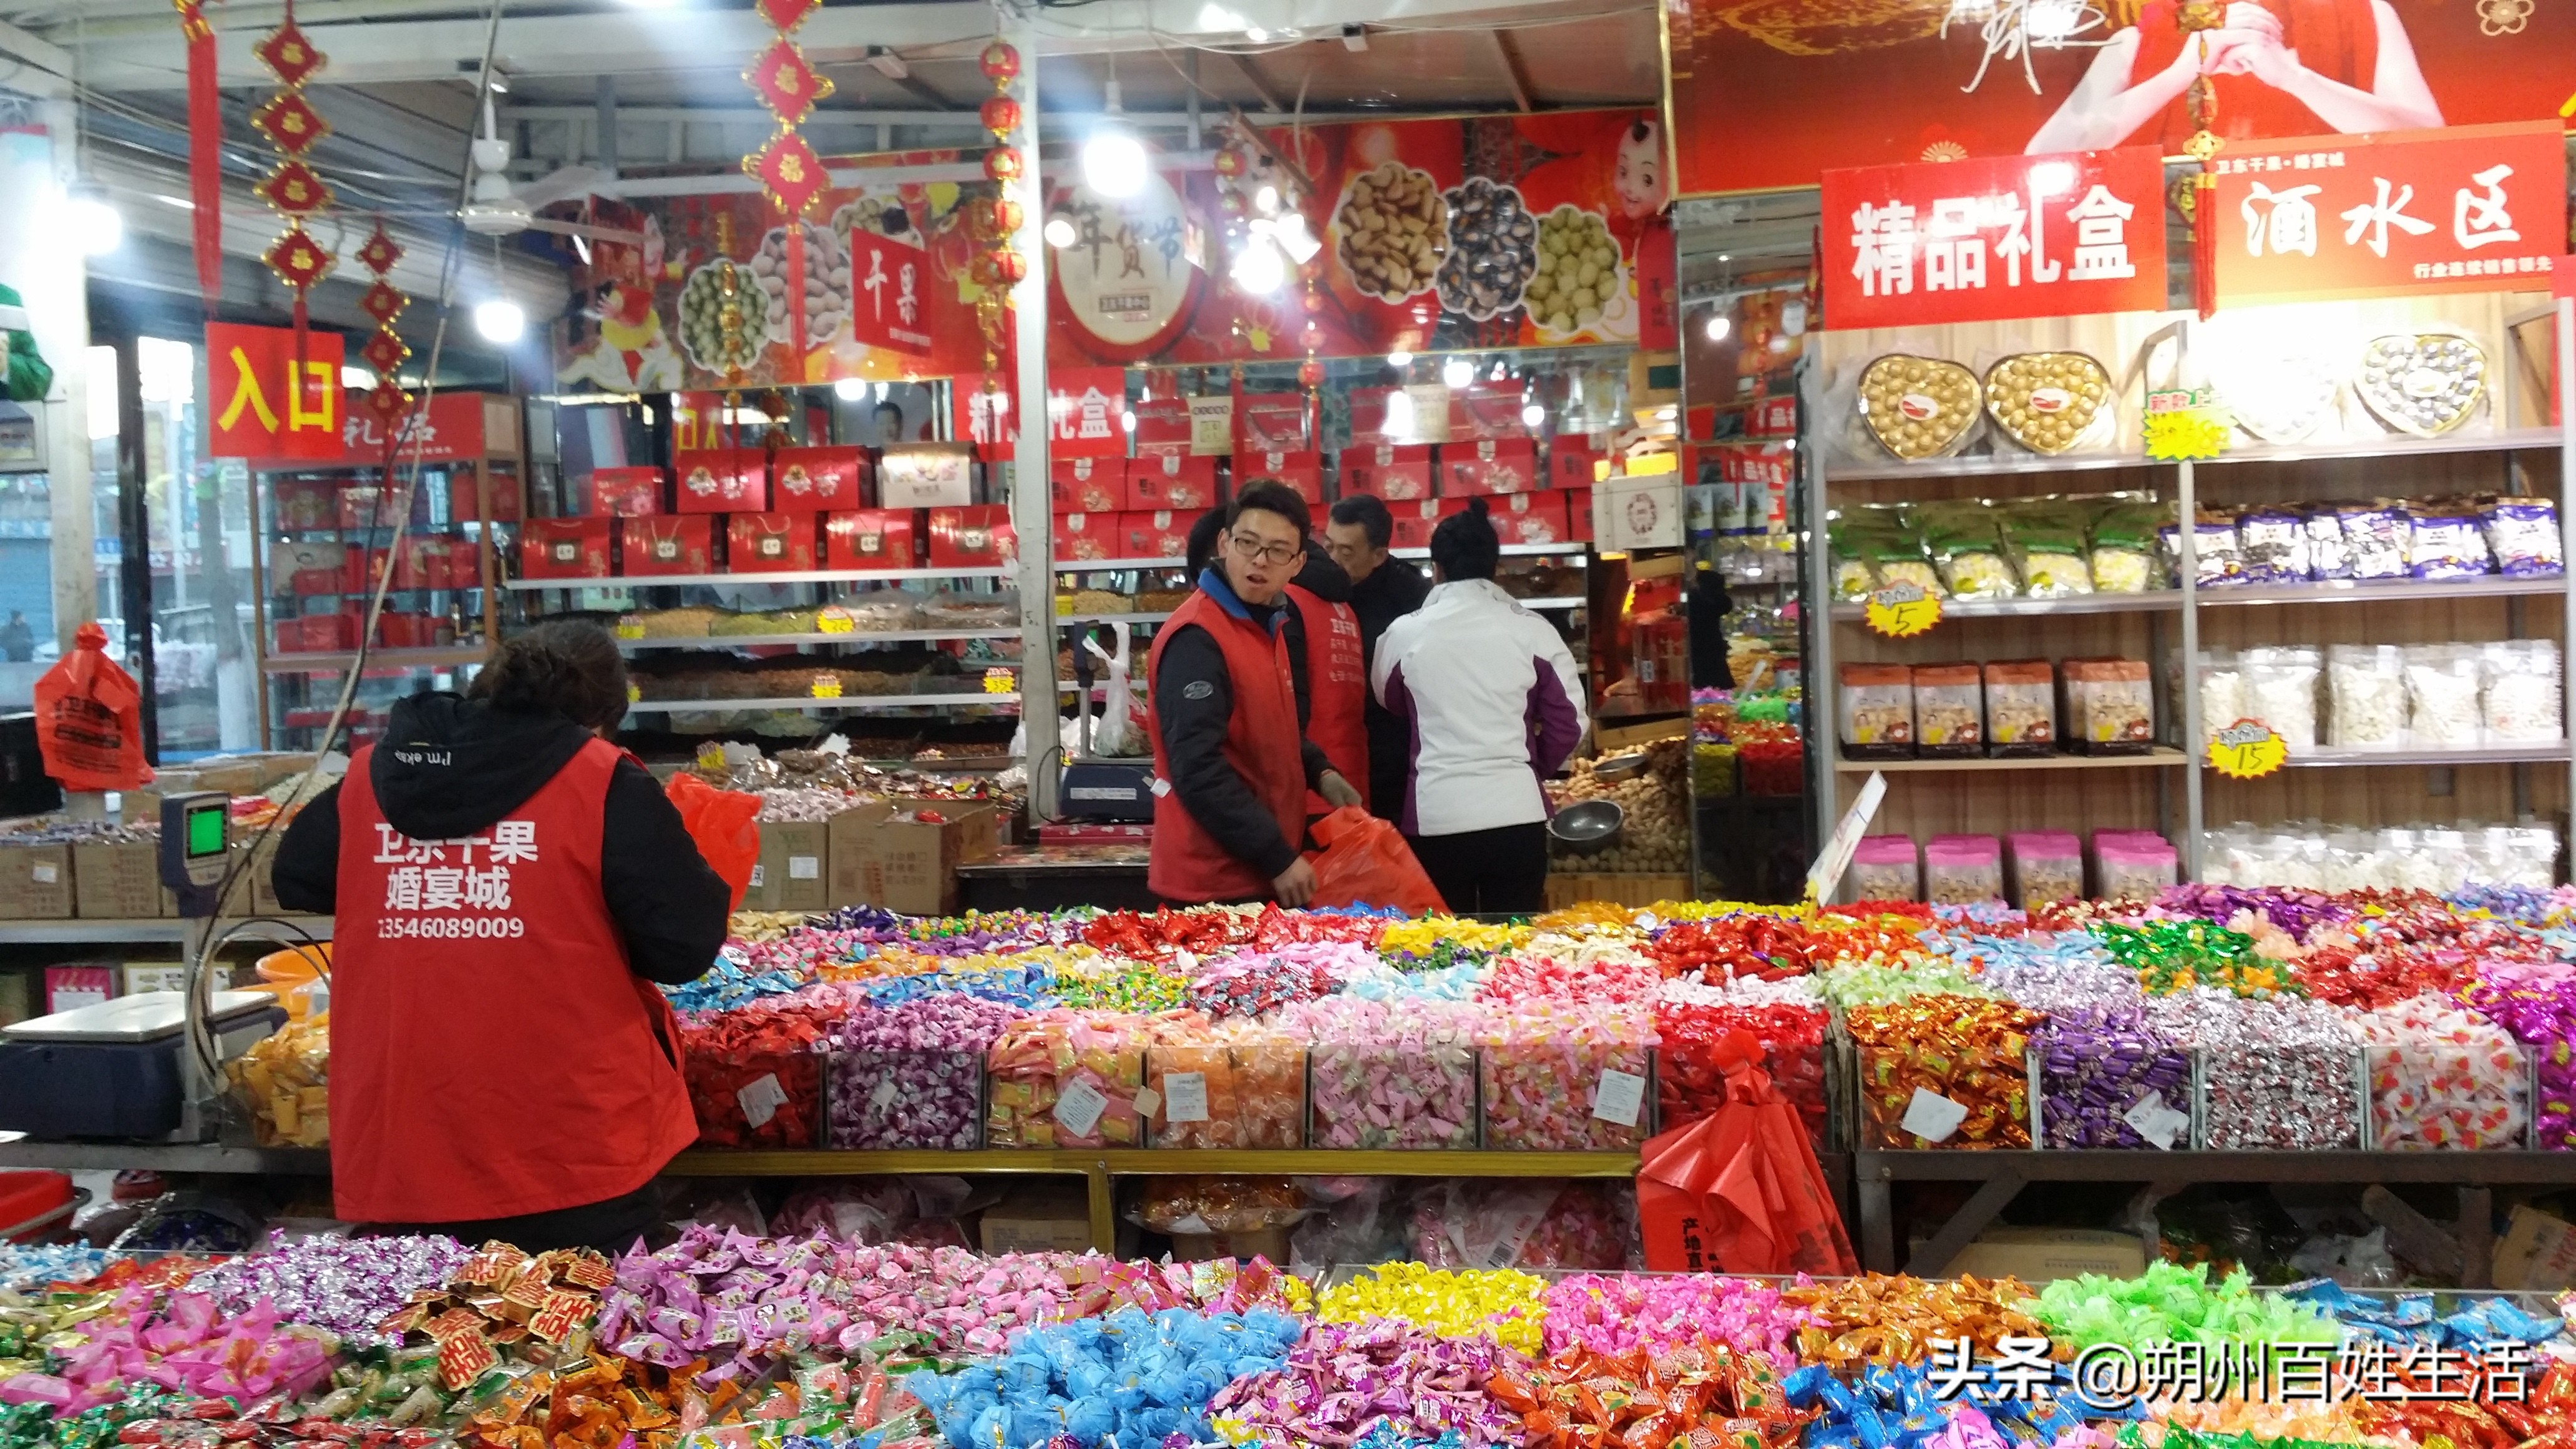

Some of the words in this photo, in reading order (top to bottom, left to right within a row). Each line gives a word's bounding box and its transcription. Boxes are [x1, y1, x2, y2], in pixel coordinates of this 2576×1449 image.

[2241, 163, 2522, 258] 酒水区
[1852, 183, 2136, 297] 精品礼盒
[218, 346, 335, 434] 入口
[1895, 606, 1918, 633] 5
[2238, 744, 2266, 769] 15
[385, 865, 512, 910] 婚宴城
[378, 917, 524, 939] 13546089009
[1682, 1216, 1704, 1272] 产地直
